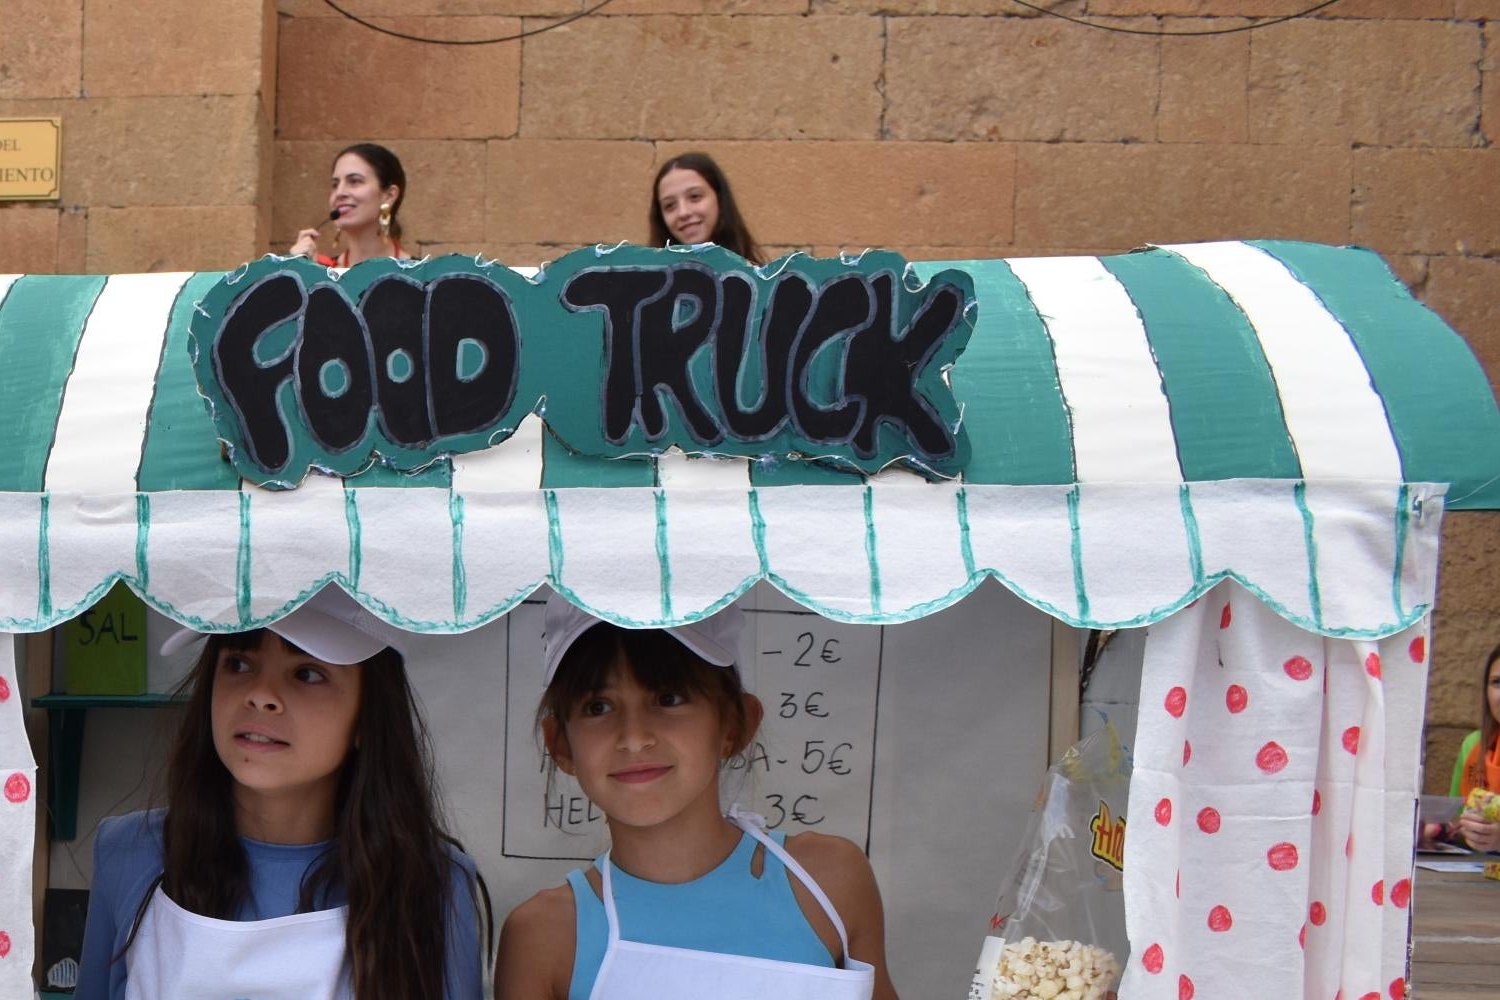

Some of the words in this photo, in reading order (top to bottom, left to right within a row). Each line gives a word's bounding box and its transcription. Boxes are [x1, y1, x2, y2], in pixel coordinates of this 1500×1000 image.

[212, 271, 519, 475] FOOD
[560, 263, 965, 461] TRUCK
[79, 609, 138, 646] SAL
